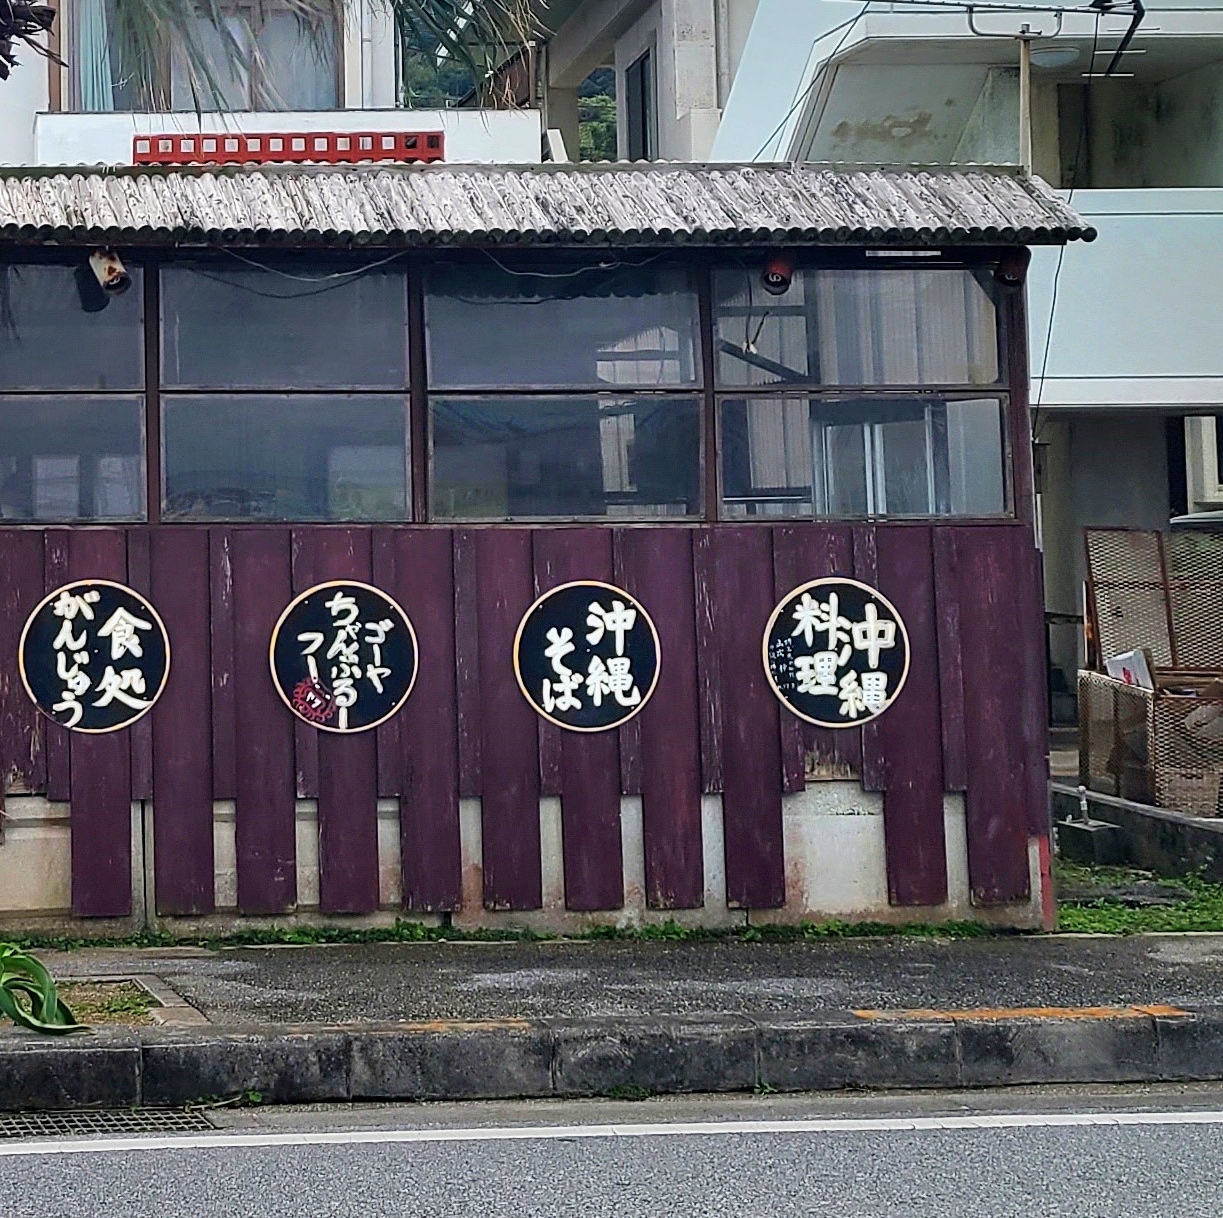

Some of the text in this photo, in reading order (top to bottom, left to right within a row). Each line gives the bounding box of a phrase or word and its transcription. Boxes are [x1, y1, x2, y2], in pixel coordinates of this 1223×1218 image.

[52, 590, 101, 729] がんじゅう
[94, 606, 154, 710] 食処
[363, 618, 395, 695] ゴーヤ
[542, 627, 585, 713] そば
[586, 600, 641, 708] 沖縄
[791, 592, 844, 697] 料理
[836, 603, 896, 719] 沖縄
